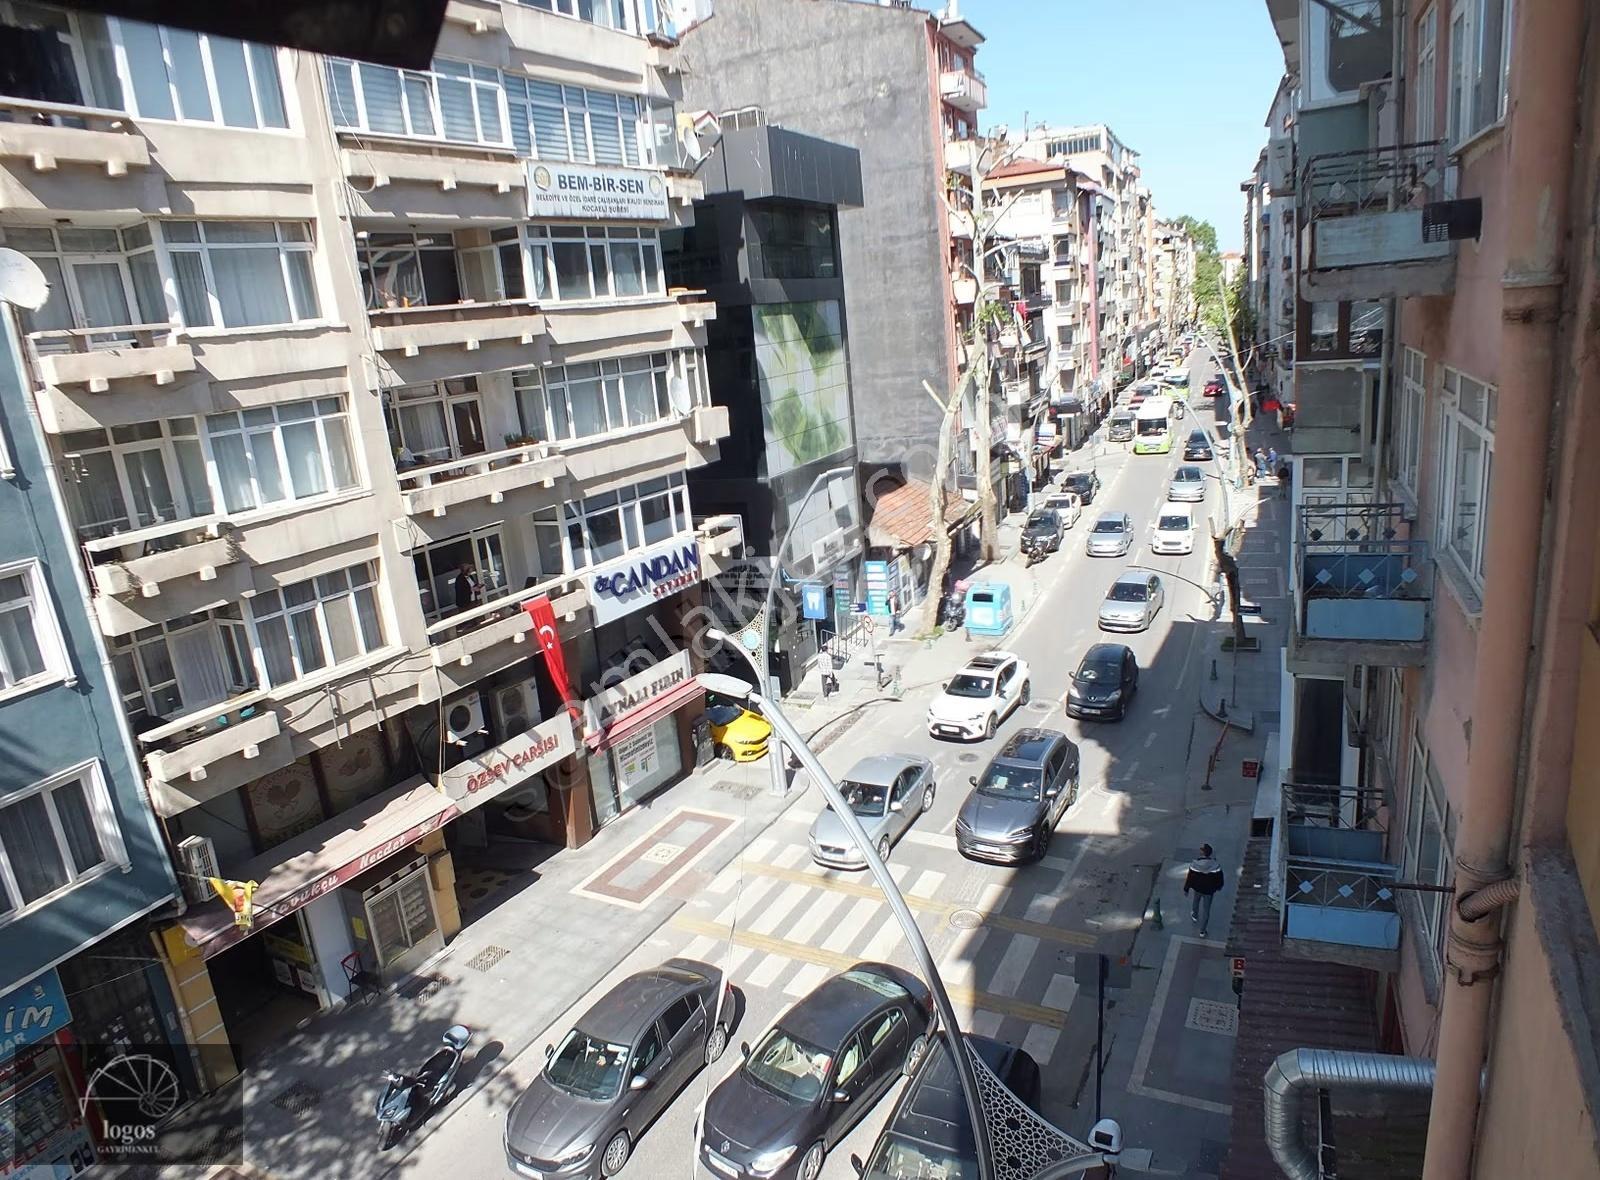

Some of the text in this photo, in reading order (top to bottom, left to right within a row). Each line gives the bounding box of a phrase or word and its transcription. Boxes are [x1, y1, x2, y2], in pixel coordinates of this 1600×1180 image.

[557, 173, 644, 194] BEM-BİR-SEN
[610, 543, 699, 597] CANDAN
[467, 760, 510, 793] ÖZSEV
[359, 835, 407, 869] Necdet
